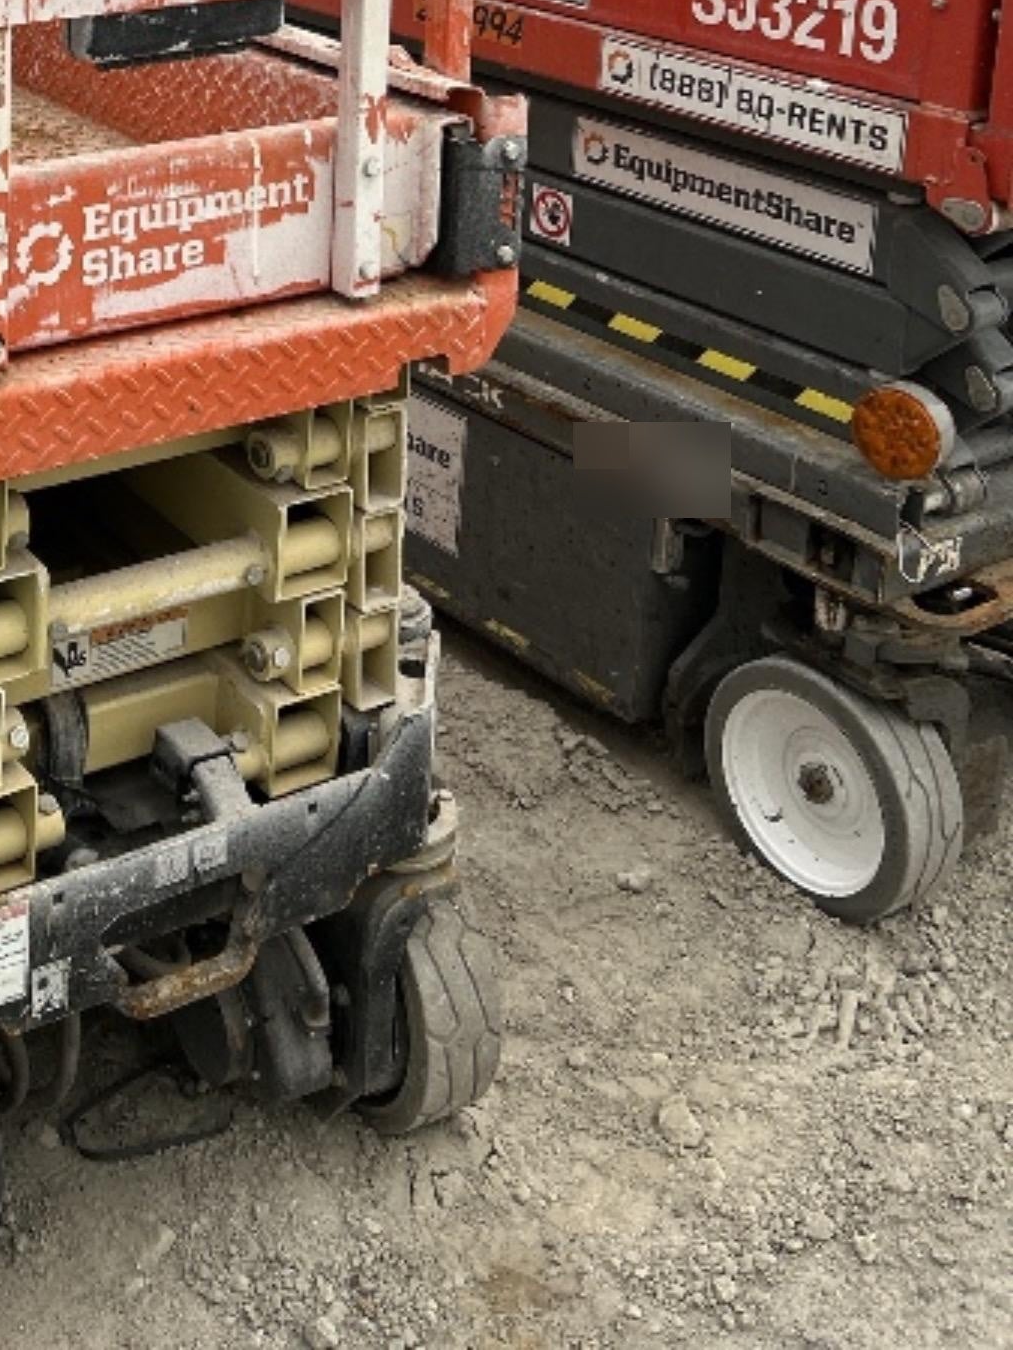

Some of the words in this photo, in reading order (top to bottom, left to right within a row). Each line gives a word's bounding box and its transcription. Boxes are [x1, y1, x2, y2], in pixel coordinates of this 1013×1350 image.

[82, 172, 310, 244] Equipment
[613, 142, 857, 244] EquipmentShare
[81, 237, 205, 287] Share
